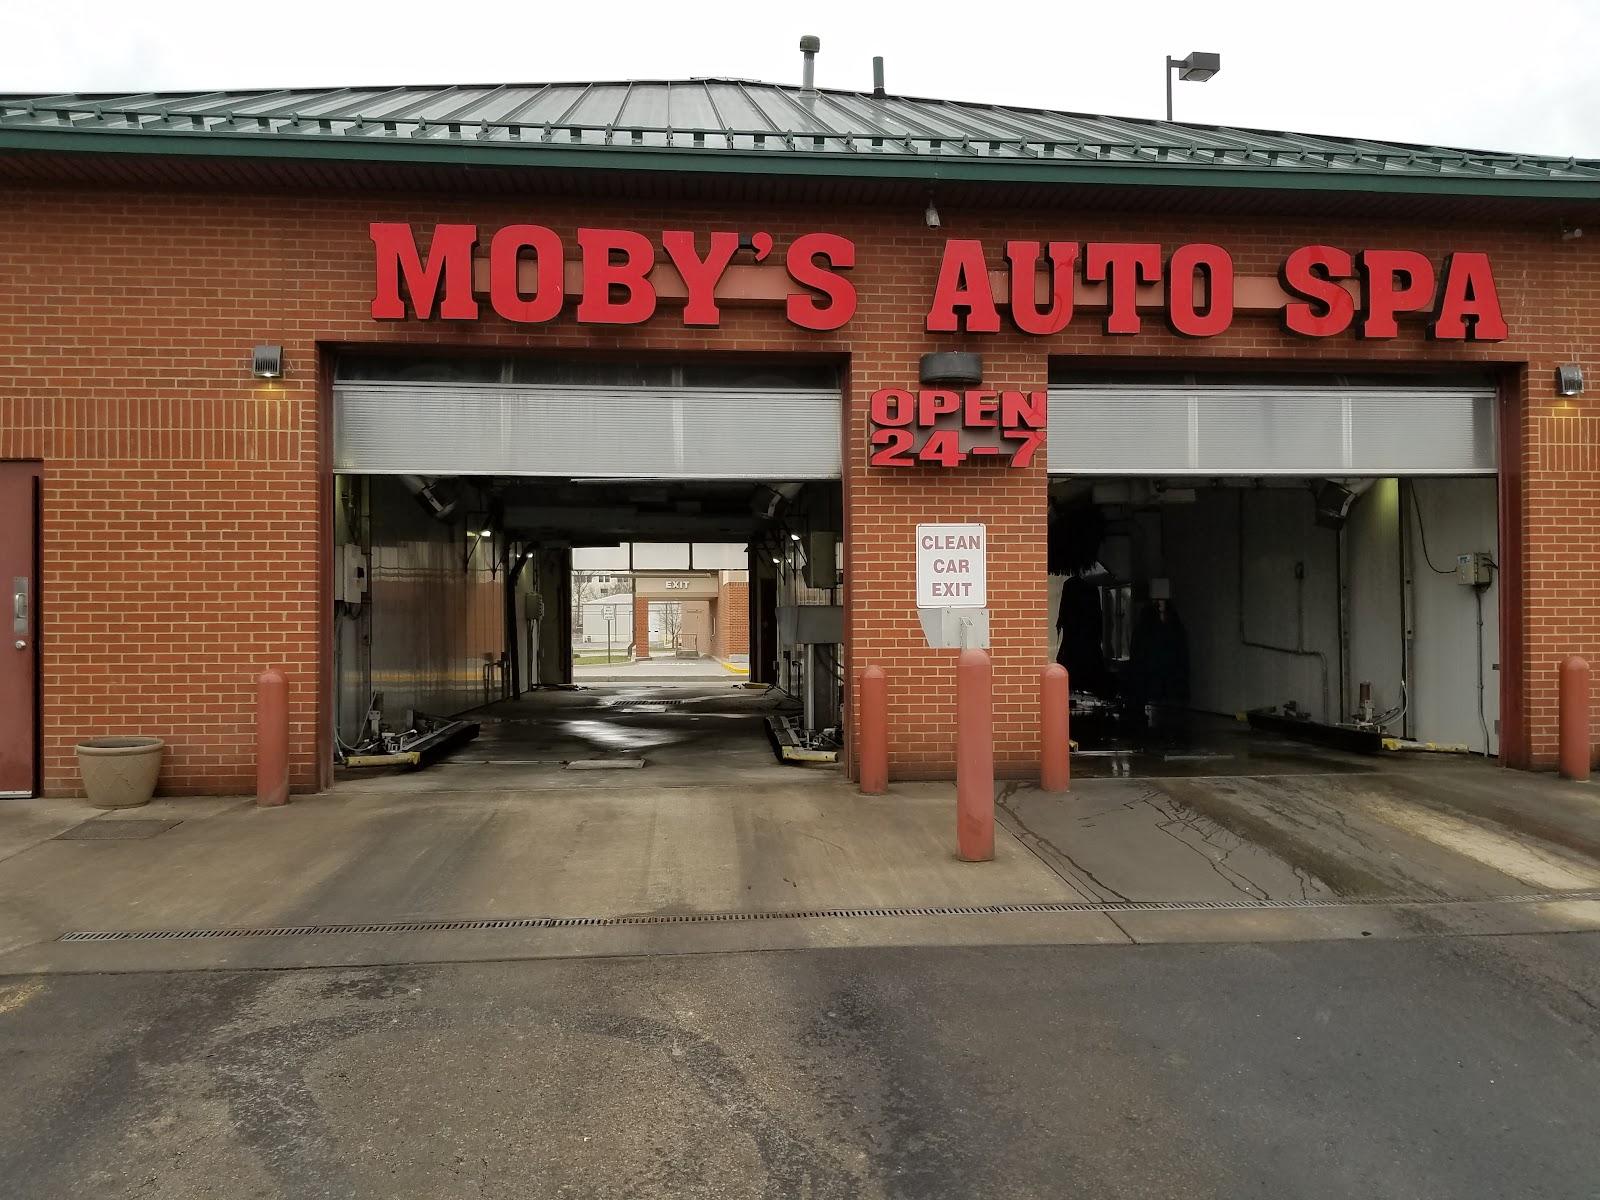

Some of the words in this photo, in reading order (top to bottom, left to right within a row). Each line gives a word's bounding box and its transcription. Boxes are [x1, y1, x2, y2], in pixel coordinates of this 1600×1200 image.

[369, 222, 858, 331] MOBY'S
[925, 239, 1234, 338] AUTO
[1281, 245, 1508, 342] SPA
[870, 388, 1047, 428] OPEN
[870, 428, 1047, 468] 24-7
[921, 535, 981, 550] CLEAN
[933, 559, 970, 574] CAR
[665, 580, 690, 590] EXIT
[931, 582, 972, 597] EXIT
